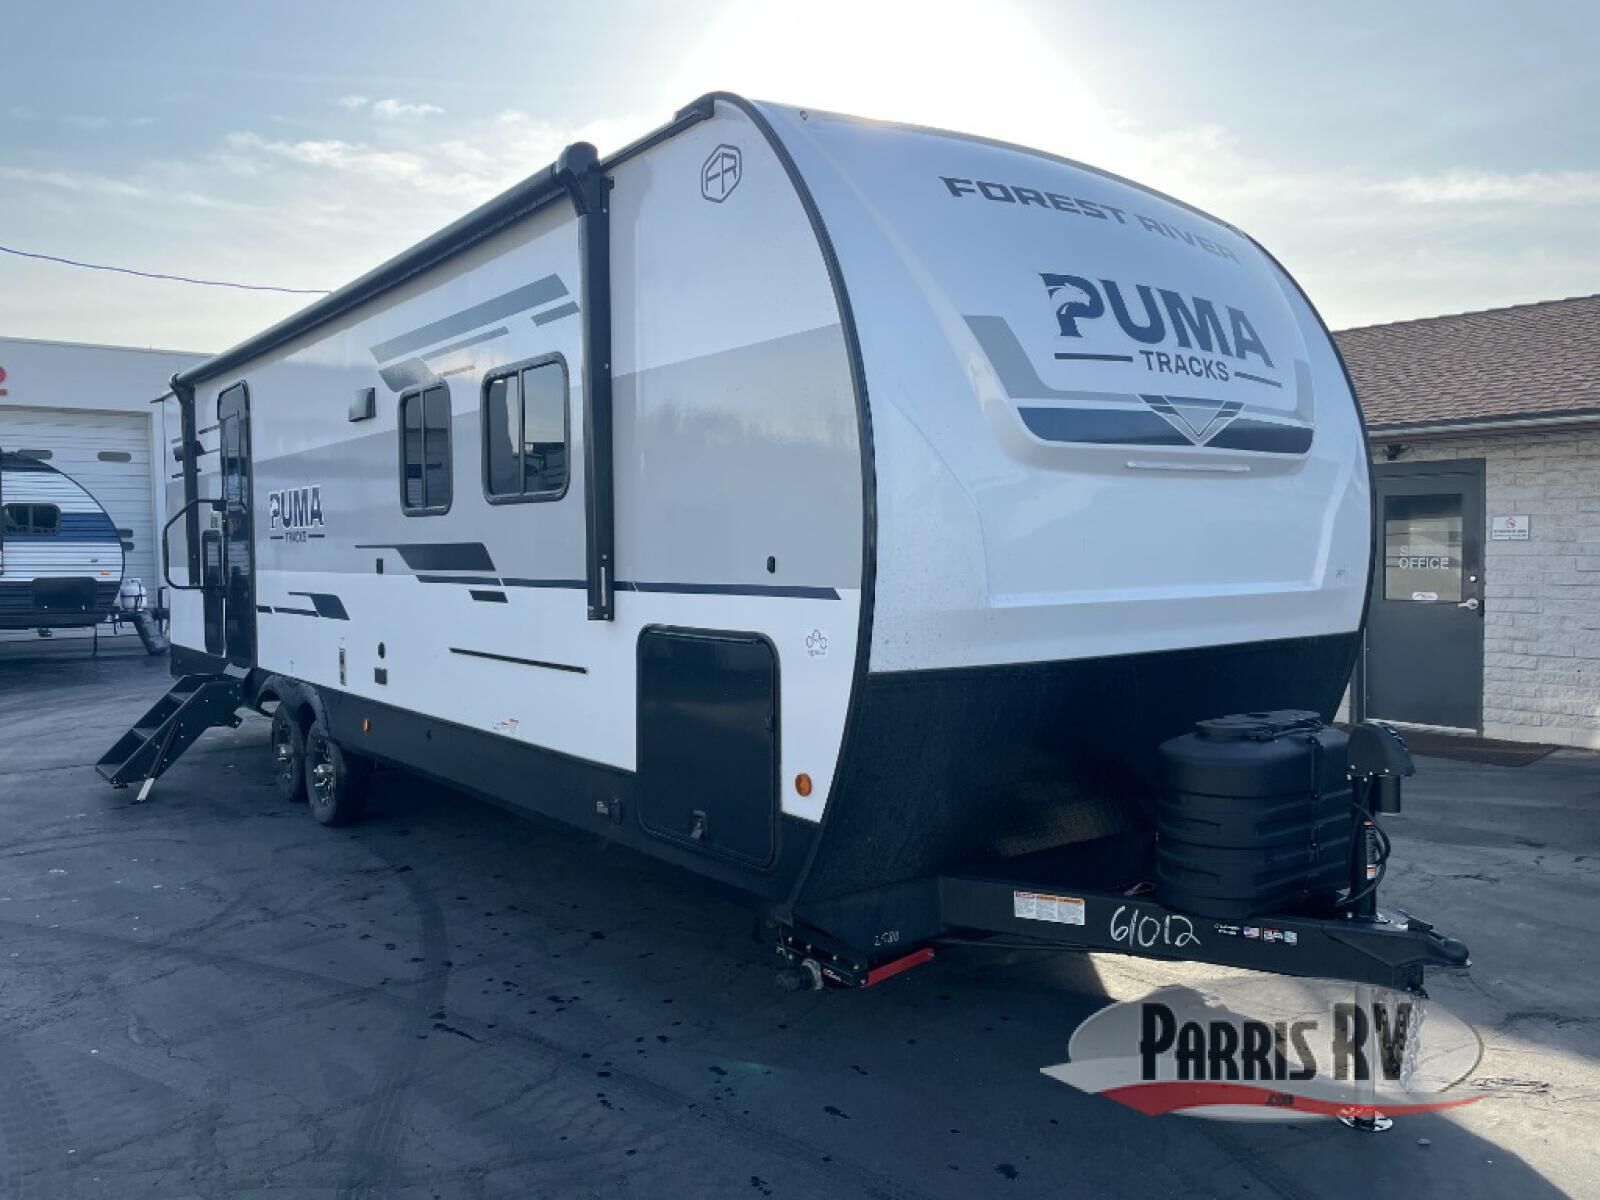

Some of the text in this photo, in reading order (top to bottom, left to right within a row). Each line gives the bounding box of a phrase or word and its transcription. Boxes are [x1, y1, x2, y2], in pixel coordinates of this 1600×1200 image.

[939, 175, 1240, 263] FOREST RIVER
[1038, 272, 1275, 369] PUMA
[1138, 350, 1230, 382] TRACKS
[269, 485, 325, 529] PUMA
[1399, 557, 1449, 570] OFFICE
[1110, 905, 1201, 948] 61012
